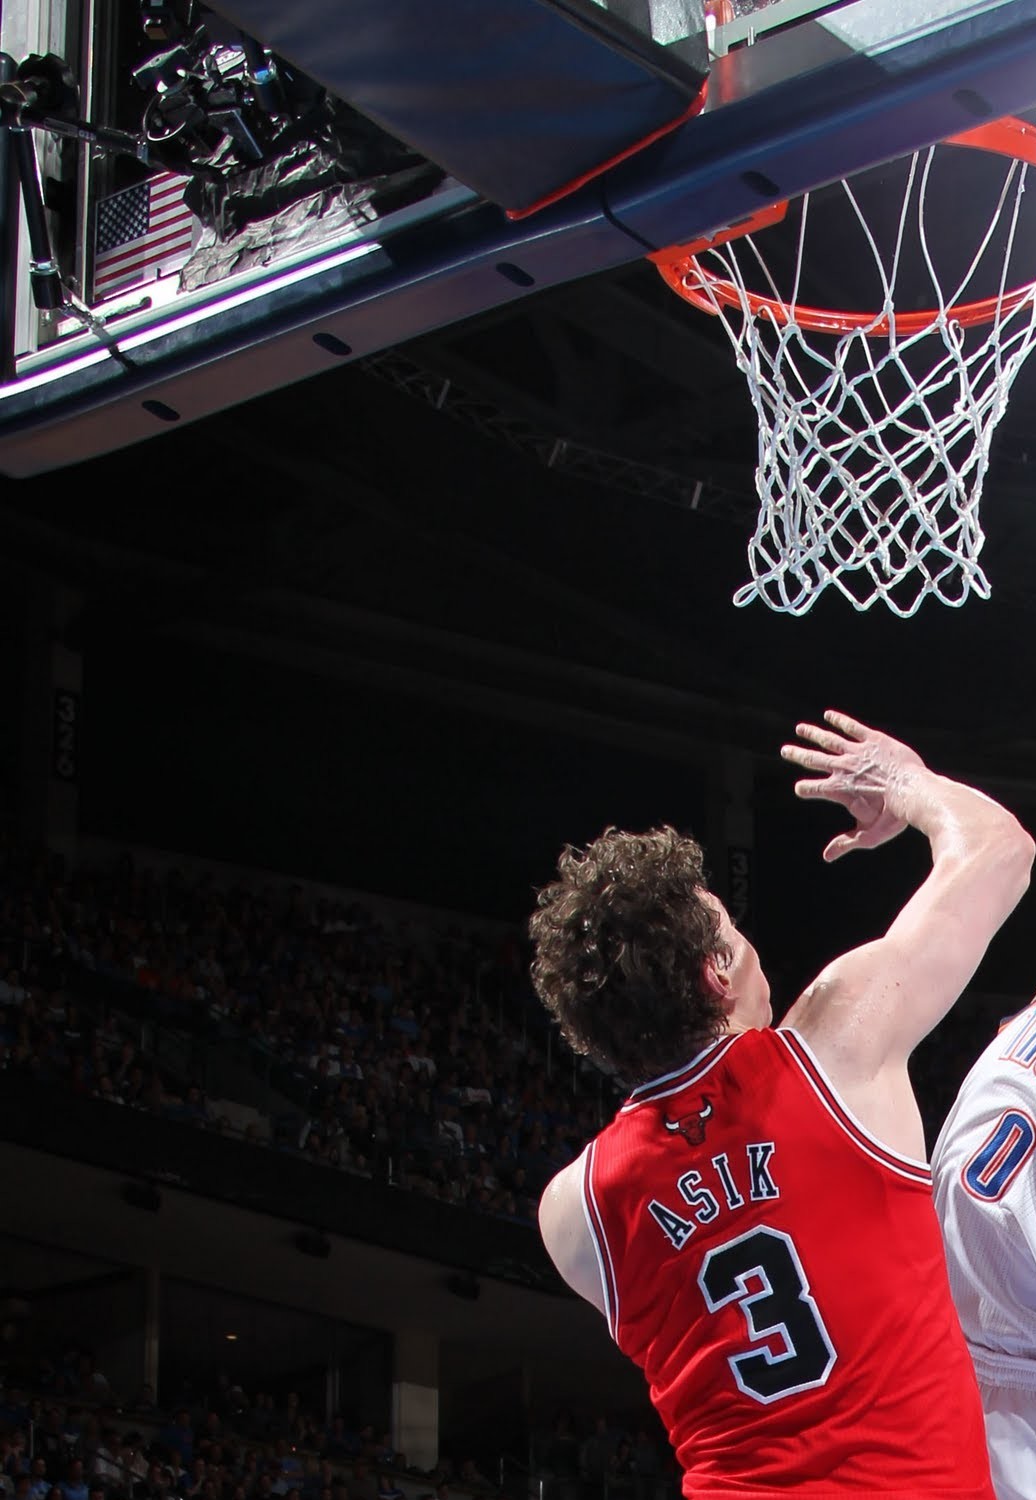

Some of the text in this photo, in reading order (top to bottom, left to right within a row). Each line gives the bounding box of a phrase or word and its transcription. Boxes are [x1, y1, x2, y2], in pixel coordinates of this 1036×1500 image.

[56, 694, 77, 777] 326
[647, 1140, 781, 1251] ASIK
[696, 1224, 838, 1405] 3
